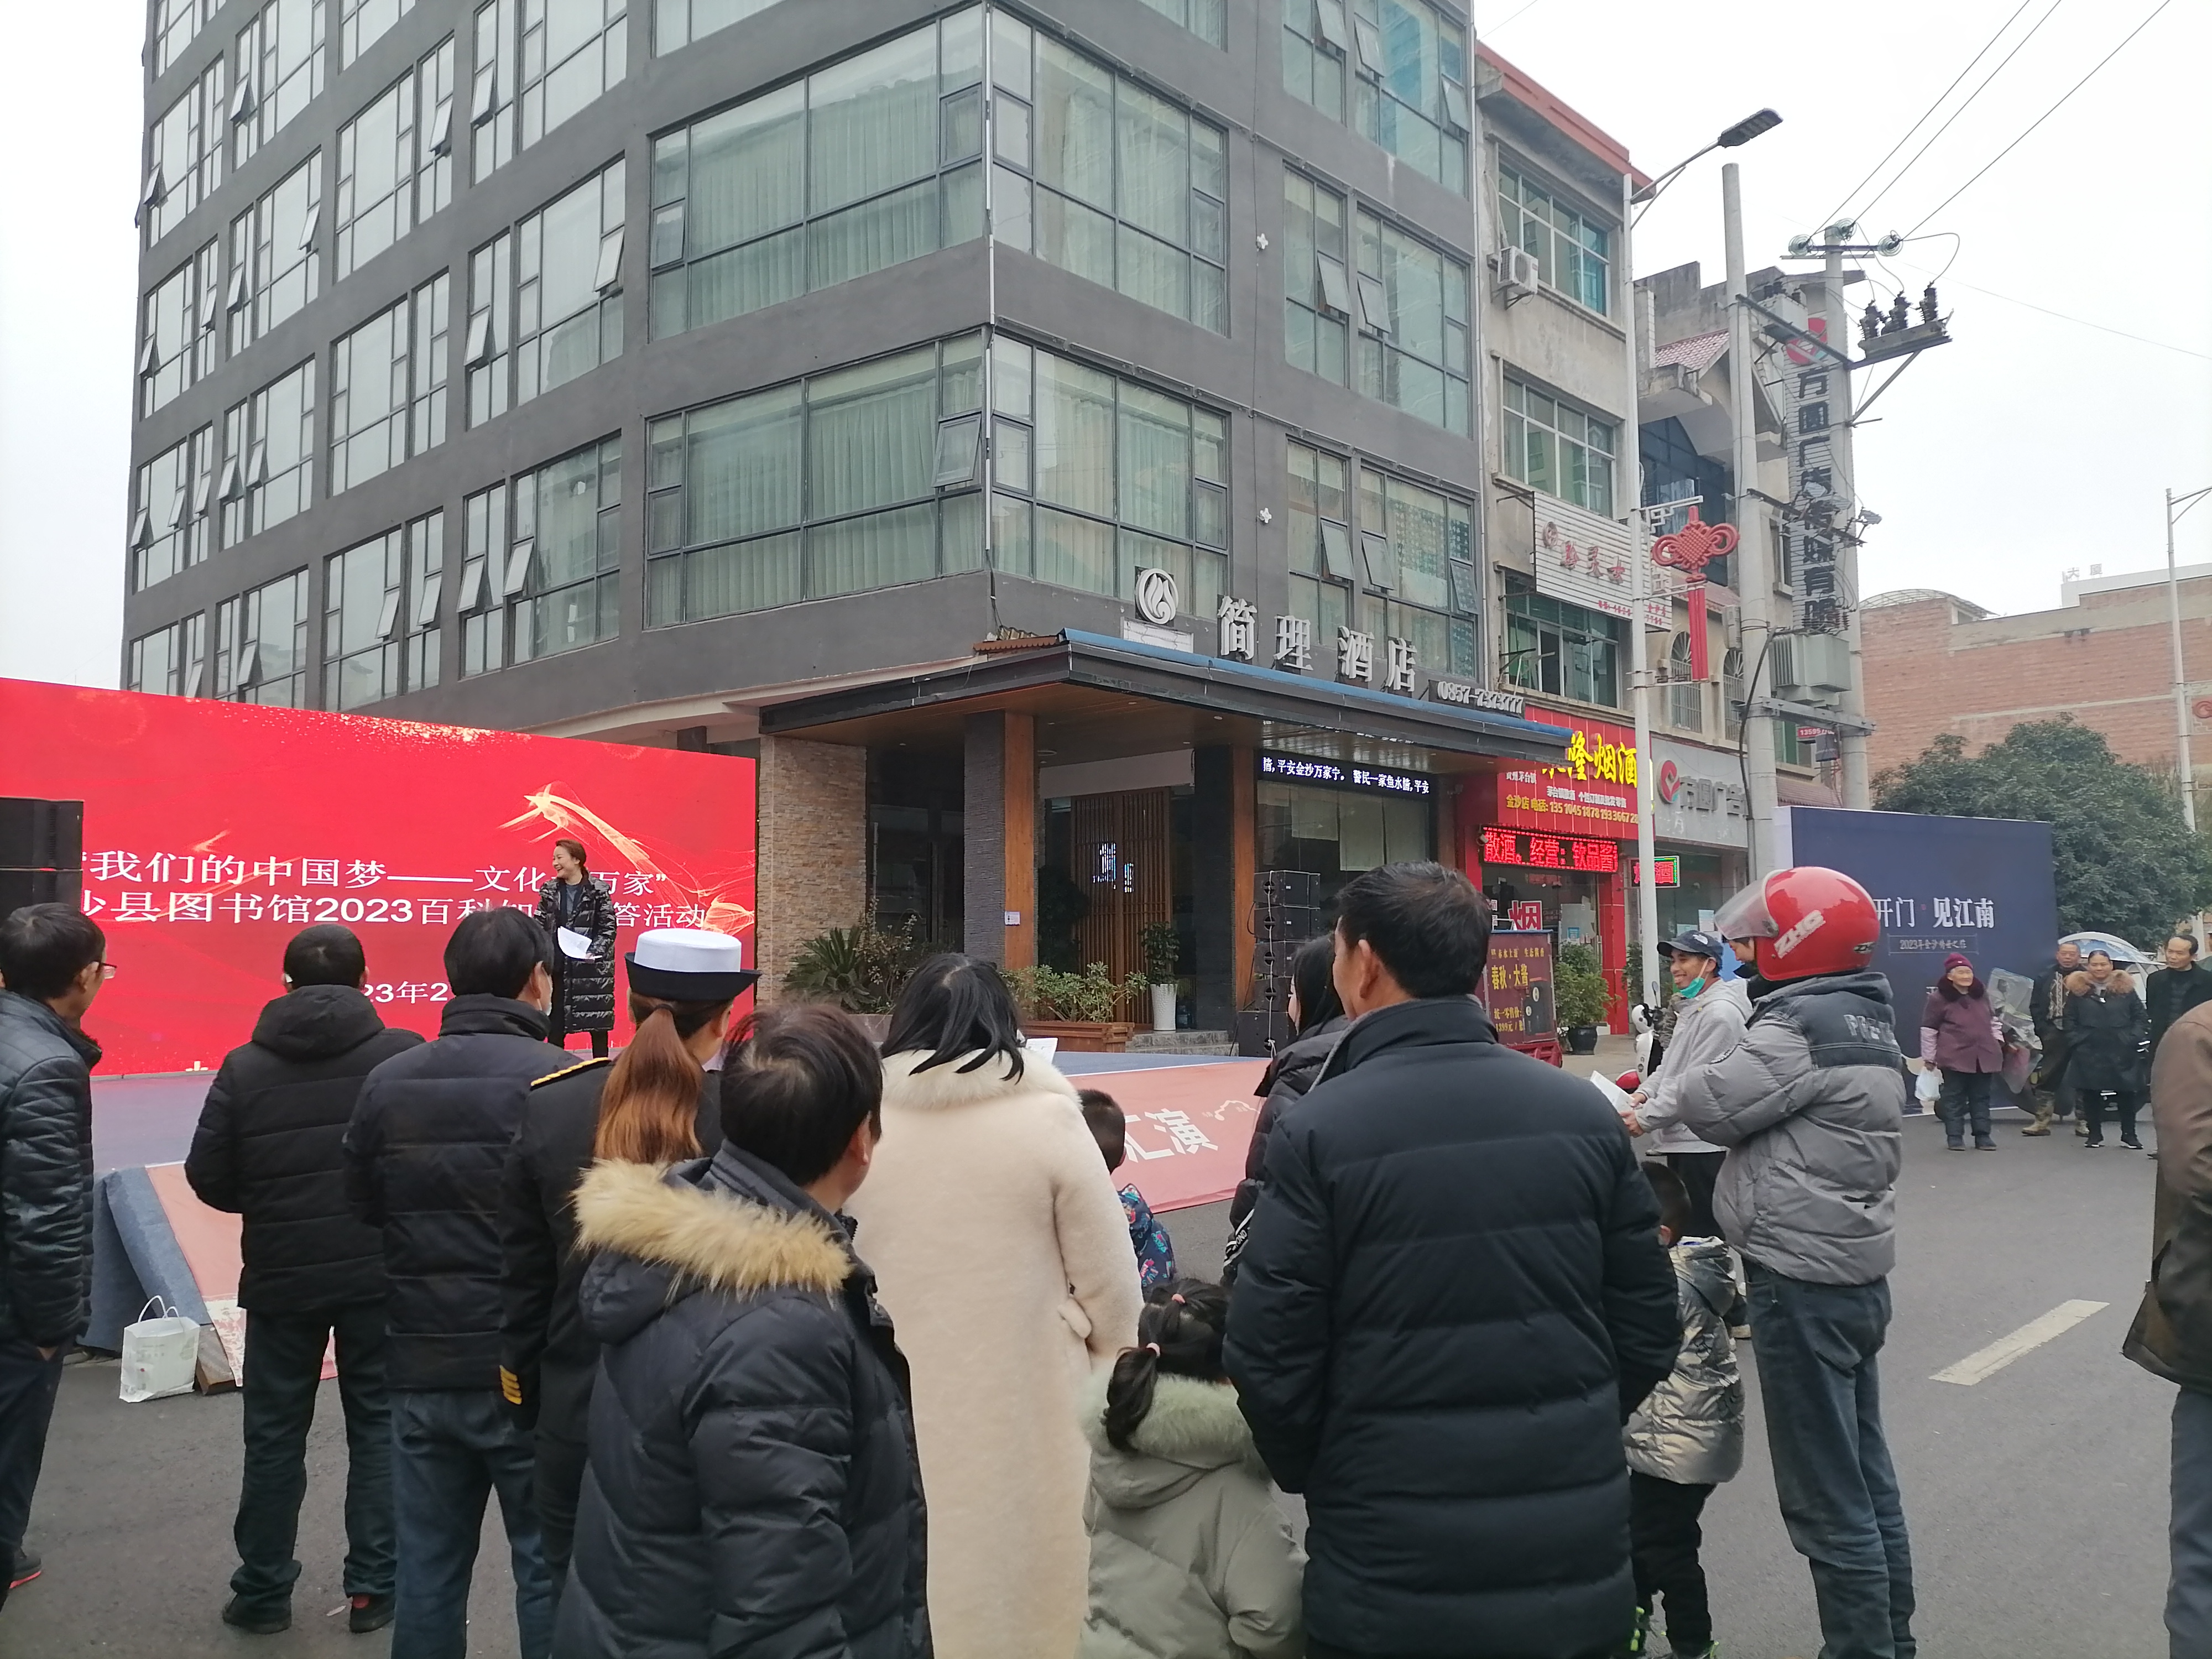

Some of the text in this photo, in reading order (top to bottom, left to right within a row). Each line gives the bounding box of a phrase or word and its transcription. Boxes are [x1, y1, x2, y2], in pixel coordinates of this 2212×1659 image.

[1217, 594, 1417, 692] 简理酒店
[1437, 681, 1524, 714] 0857-7373777
[1542, 731, 1638, 788] 隆烟酒
[1506, 794, 1530, 810] 金沙店
[1507, 900, 1542, 930] 烟
